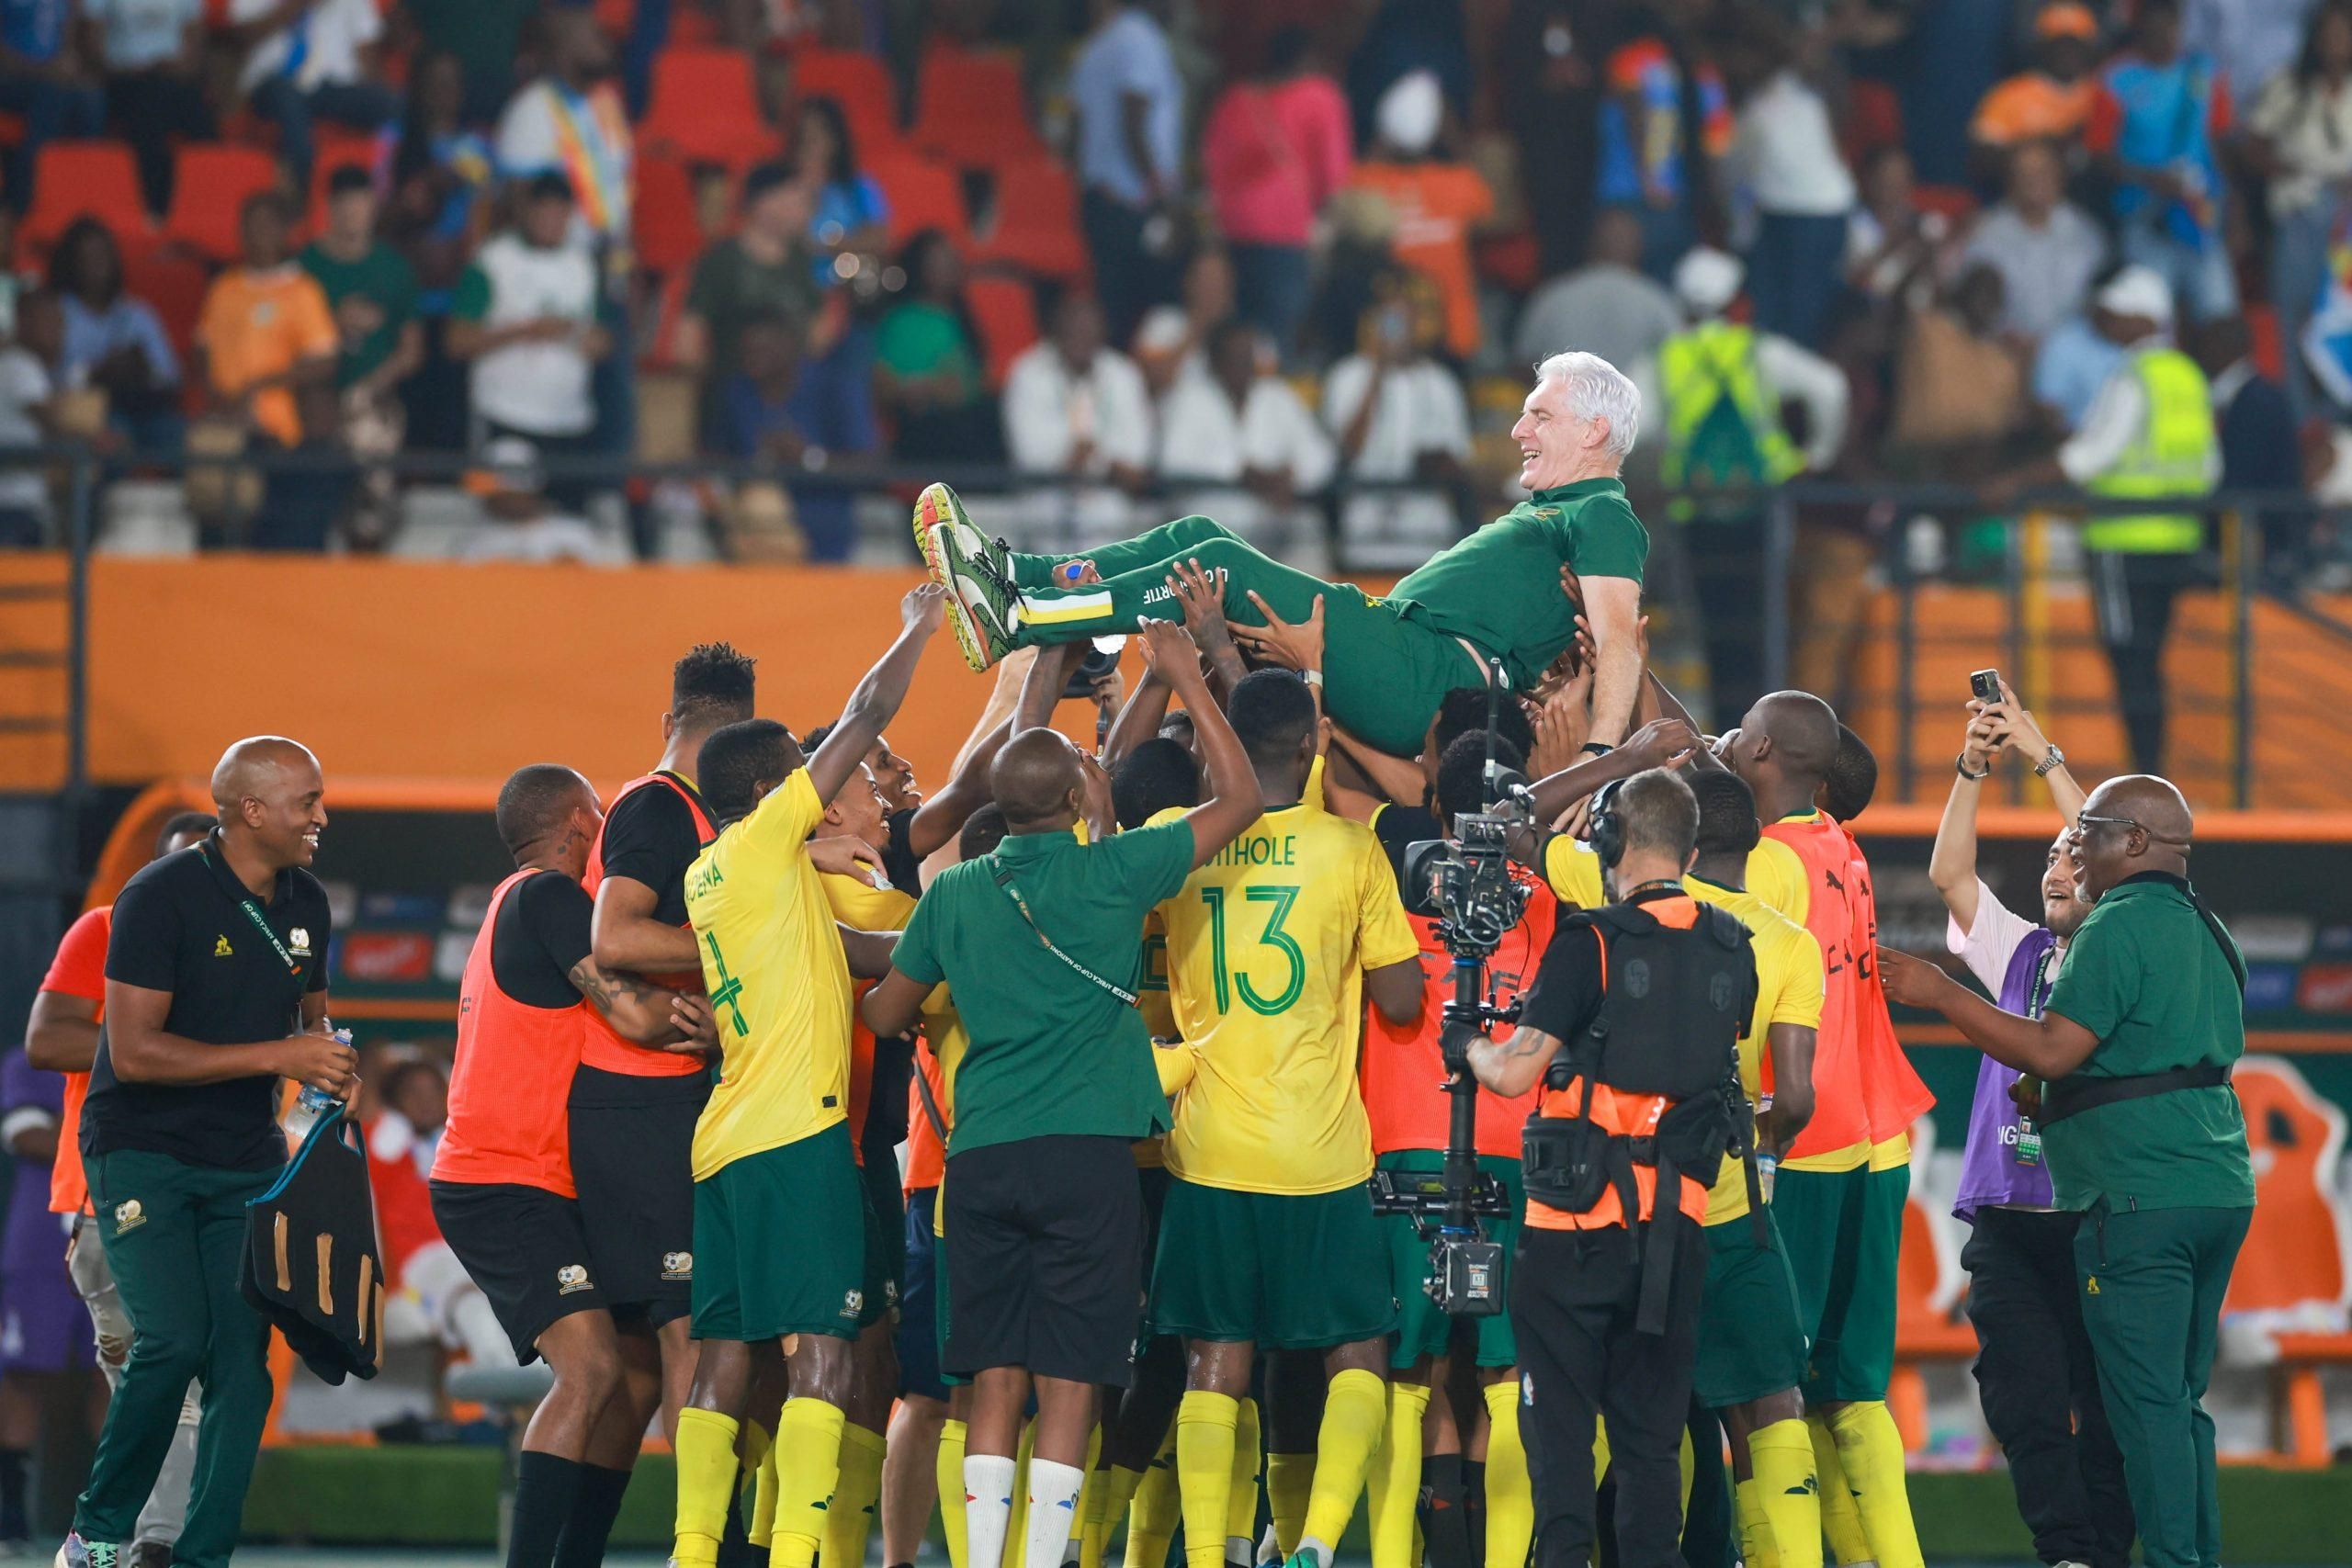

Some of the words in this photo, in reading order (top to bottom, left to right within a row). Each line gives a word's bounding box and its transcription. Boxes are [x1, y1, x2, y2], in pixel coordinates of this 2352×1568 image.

[1049, 945, 1074, 965] NATIONS
[1201, 885, 1306, 1016] 13
[1072, 962, 1082, 971] OF
[1080, 967, 1093, 979] CUP
[706, 931, 750, 1037] 4
[1092, 975, 1113, 990] AFRICA
